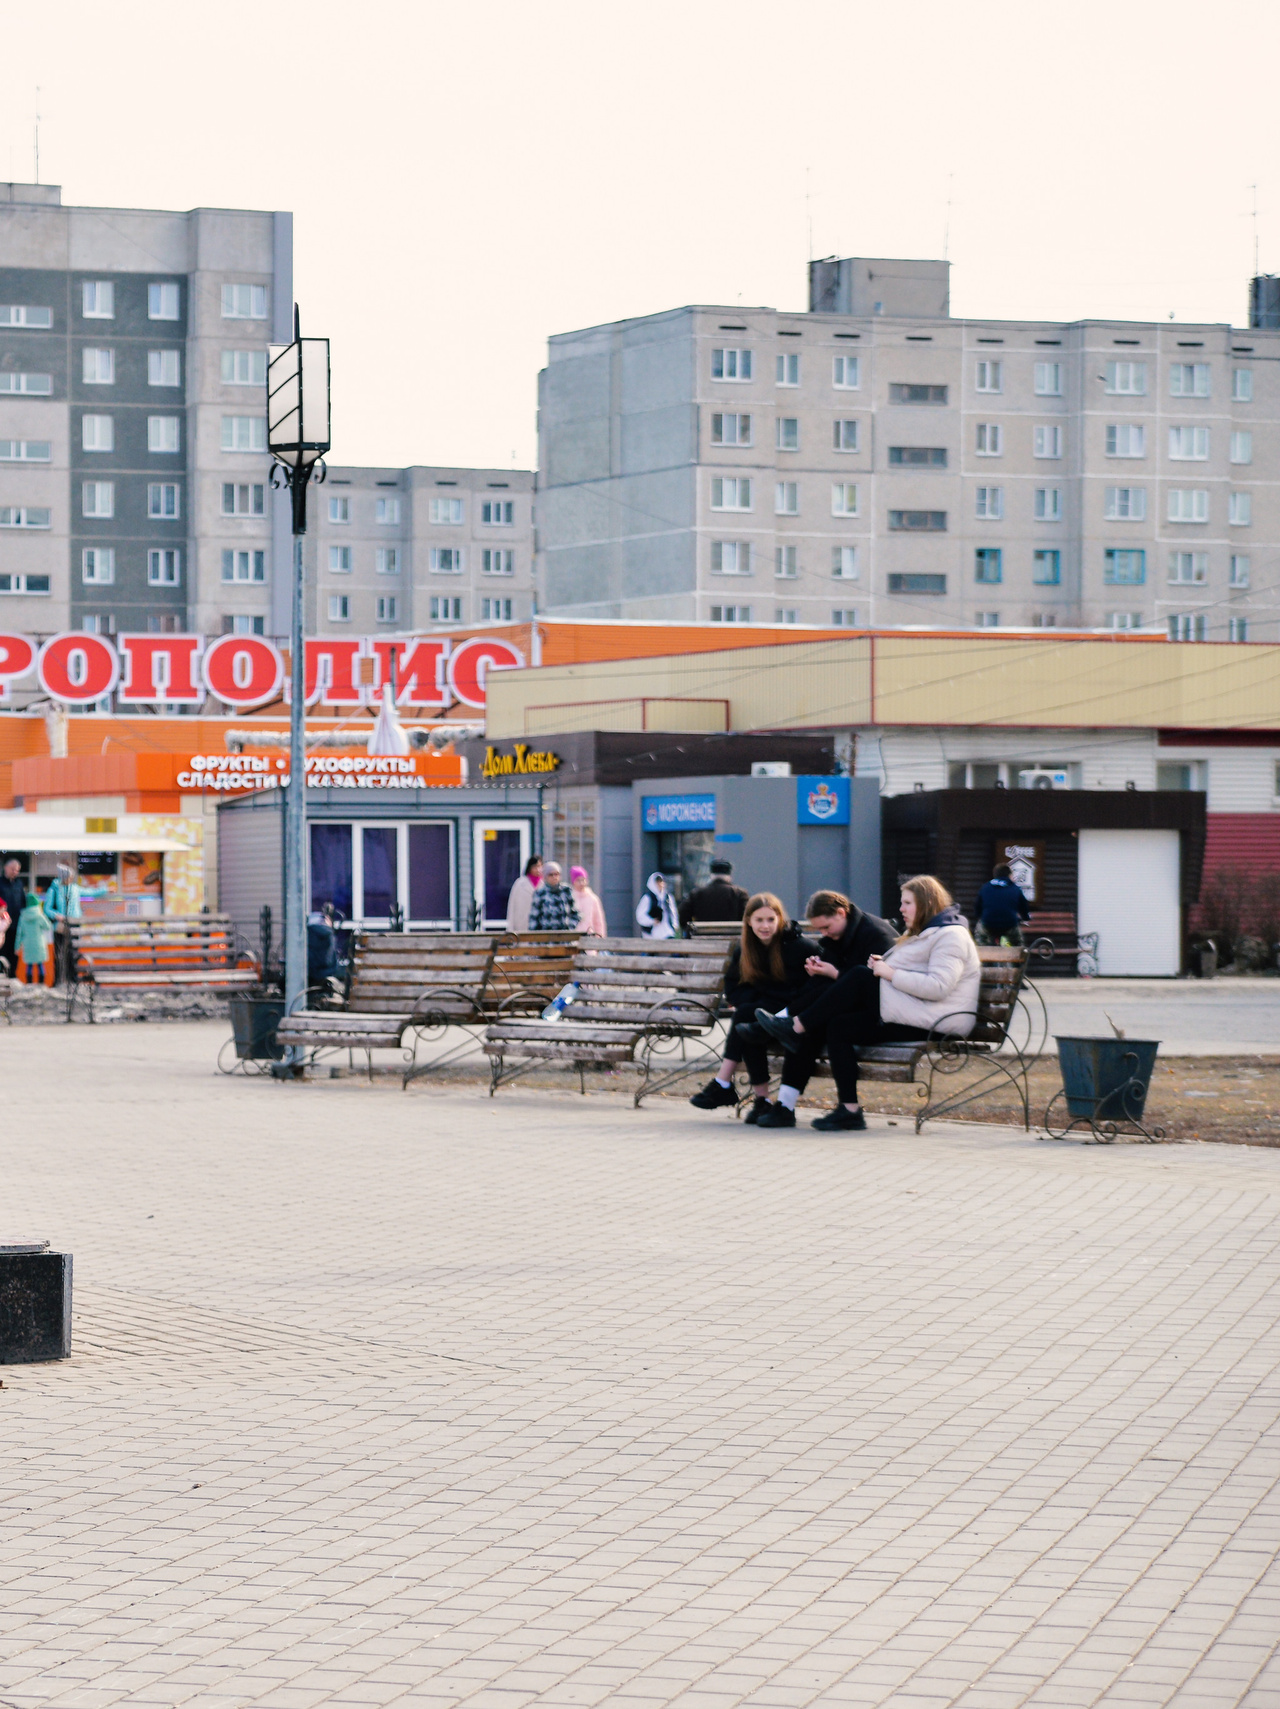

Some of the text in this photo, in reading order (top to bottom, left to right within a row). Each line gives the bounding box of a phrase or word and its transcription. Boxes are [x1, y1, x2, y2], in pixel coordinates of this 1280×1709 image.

[190, 755, 416, 773] ФРУКТЫ УХОФРУКТЫ
[177, 771, 278, 790] СЛАДОСТИ
[307, 774, 428, 788] КАЗАХСТАНА
[659, 802, 715, 822] МОРОЖЕНОЕ
